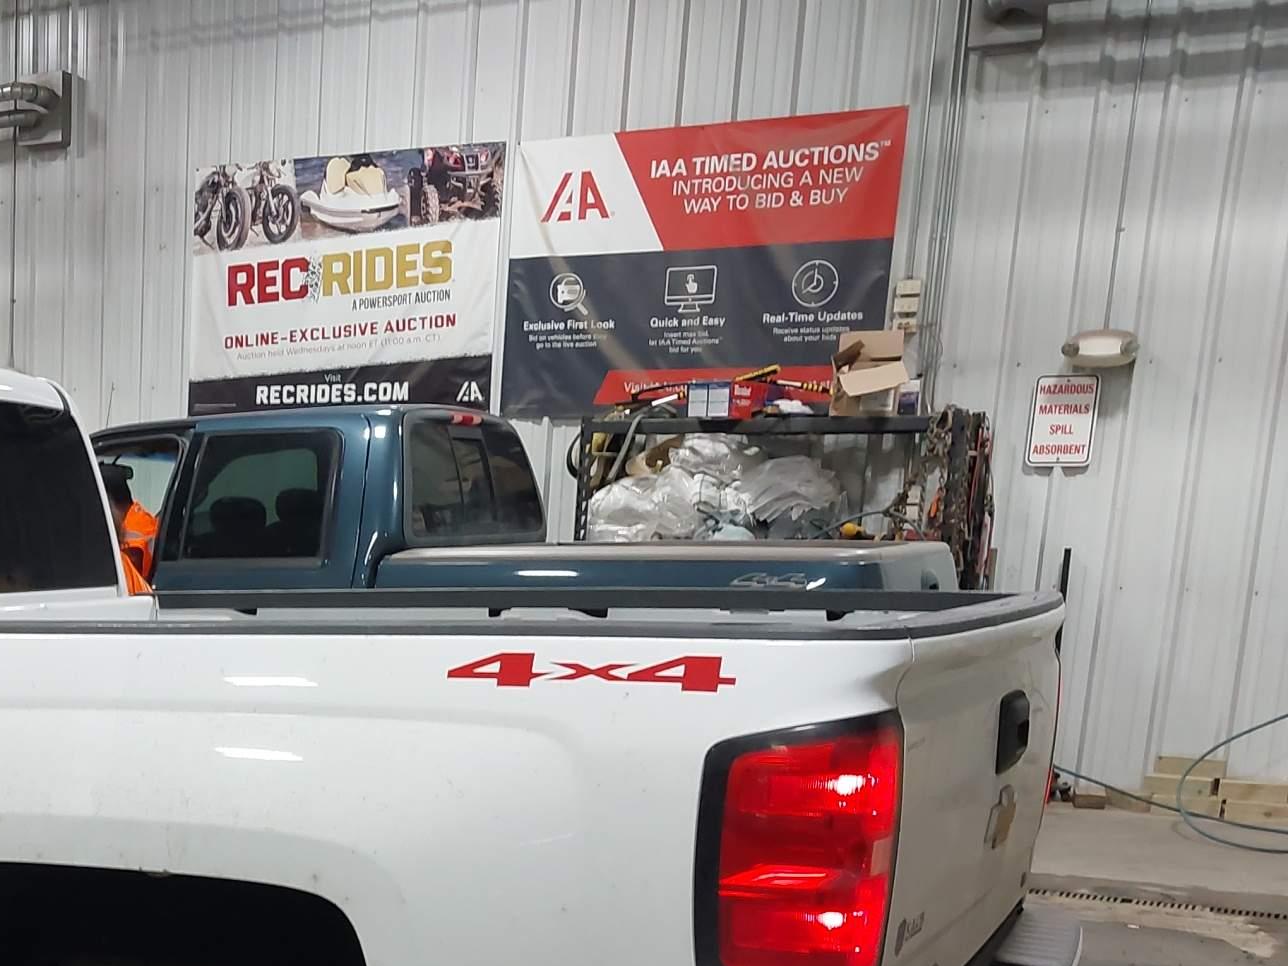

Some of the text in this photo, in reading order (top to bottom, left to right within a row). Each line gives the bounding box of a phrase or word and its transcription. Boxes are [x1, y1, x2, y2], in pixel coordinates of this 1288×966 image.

[650, 158, 687, 179] IAA
[692, 153, 757, 174] TIMED
[672, 166, 864, 196] INTRODUCING A NEW
[684, 186, 849, 214] WAY TO BID & BUY
[227, 240, 453, 306] REC RIDES
[352, 289, 451, 311] A POWERSPORT AUCTION
[650, 315, 726, 328] Quick and Easy
[762, 310, 864, 323] Real-Time Updates
[224, 313, 457, 349] ONLINE-EXCLUSIVE AUCTION
[523, 318, 615, 331] Exclusive First Look
[236, 351, 266, 361] Auction
[324, 373, 342, 383] Visit
[255, 380, 409, 405] RECRIDES.COM
[1039, 383, 1095, 395] HAZARDOUS
[1038, 403, 1091, 415] MATERIALS
[1049, 423, 1074, 435] SPILL
[1032, 443, 1086, 456] ABSORBENT
[447, 652, 737, 693] 4x4
